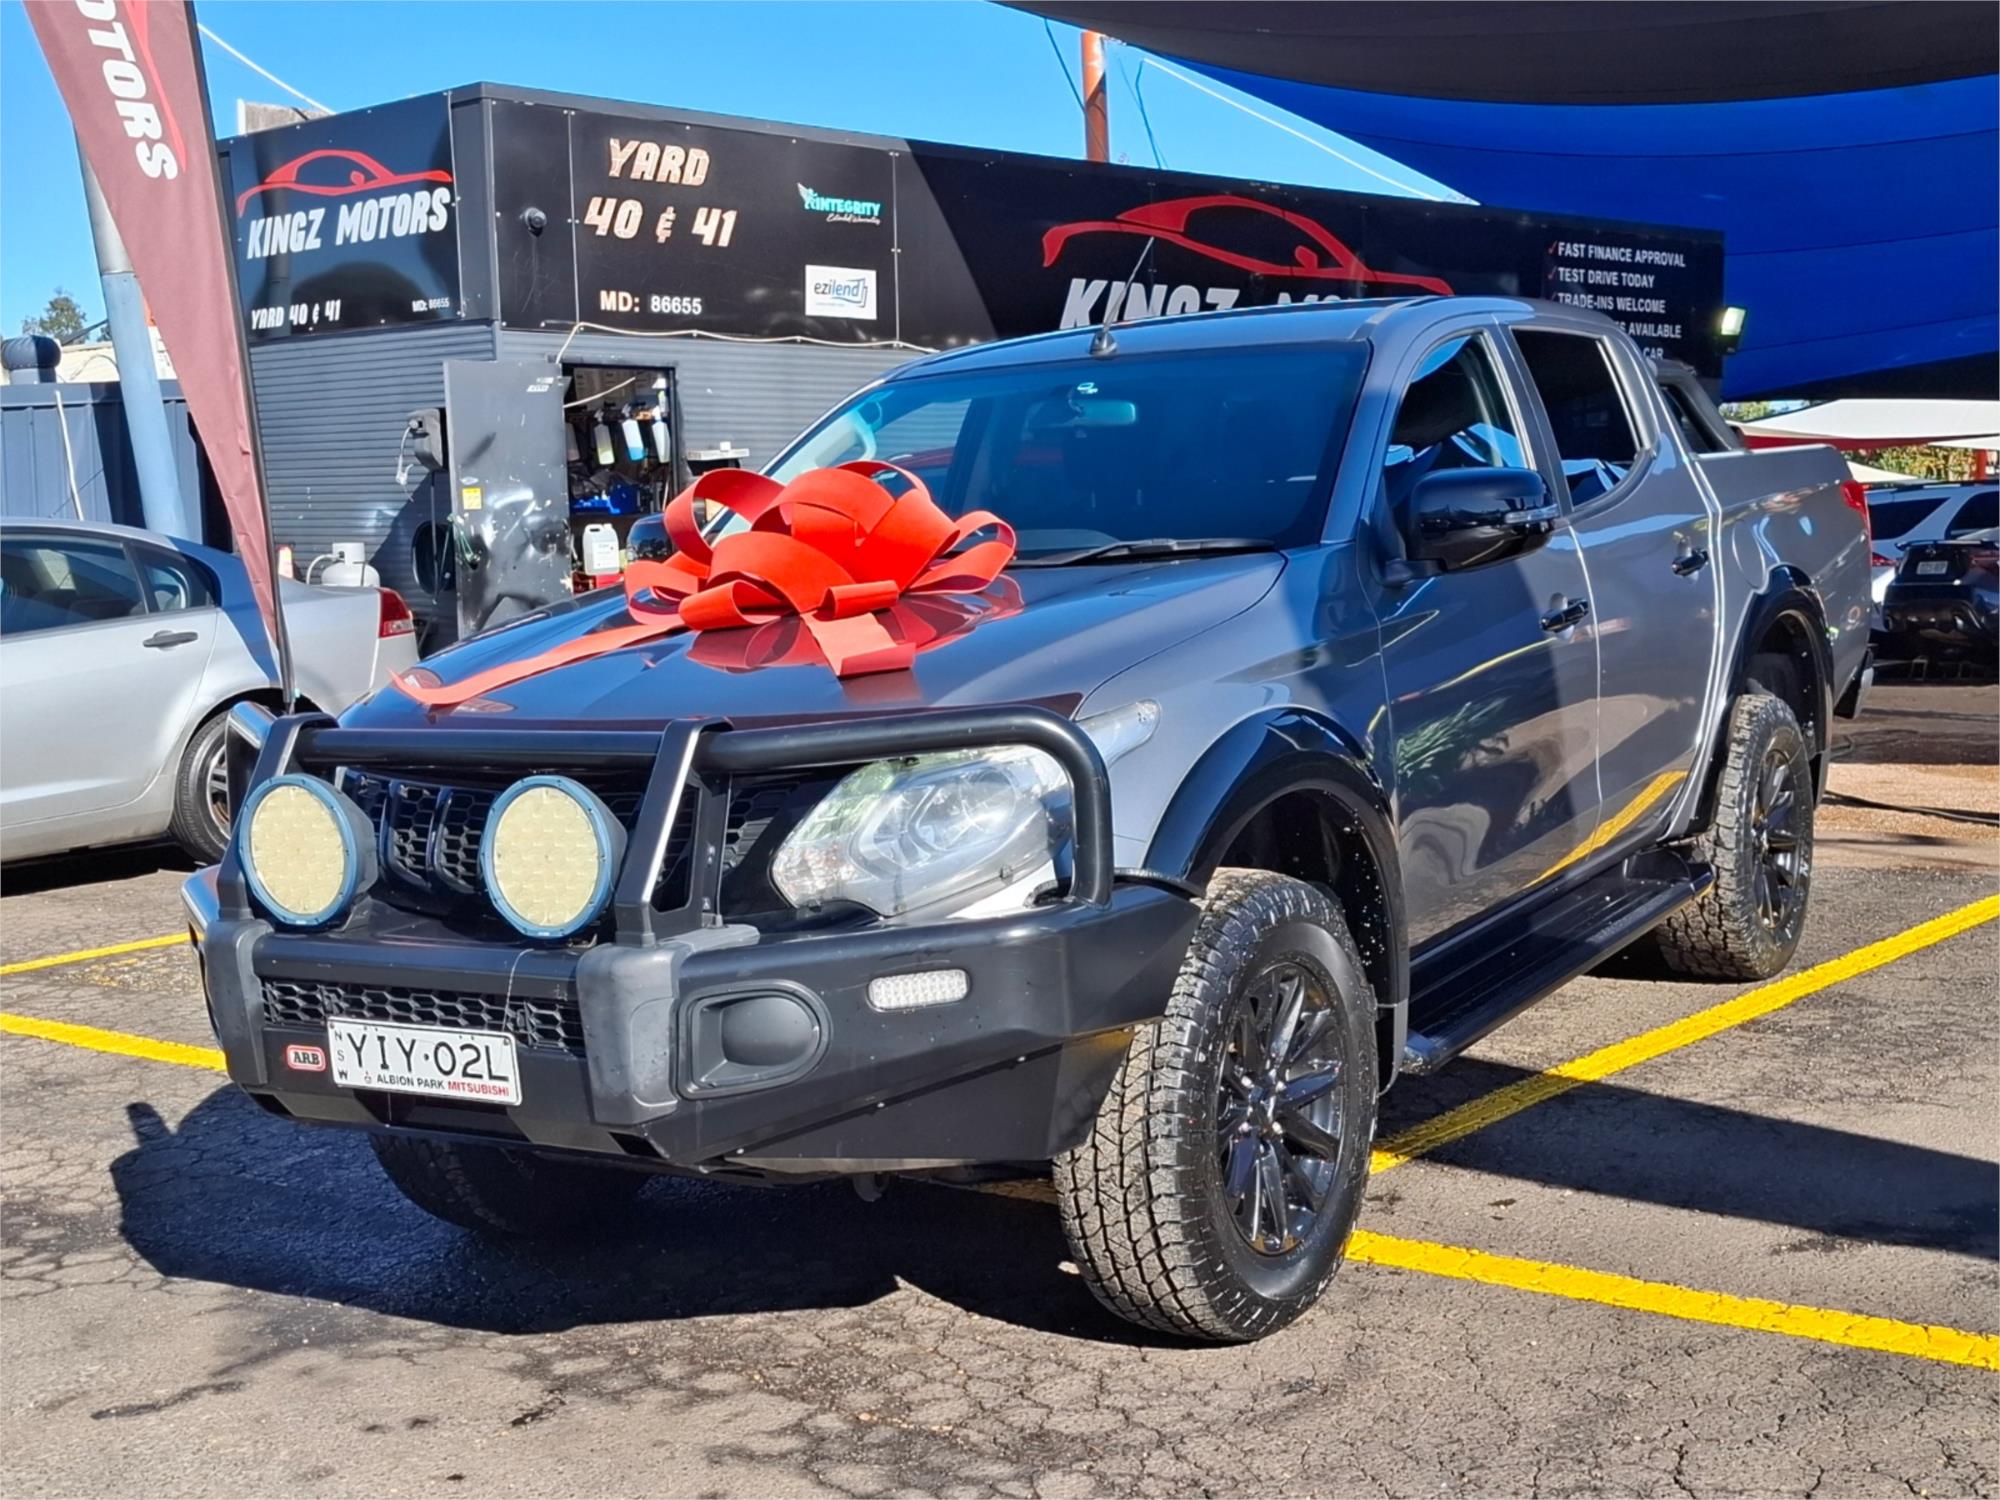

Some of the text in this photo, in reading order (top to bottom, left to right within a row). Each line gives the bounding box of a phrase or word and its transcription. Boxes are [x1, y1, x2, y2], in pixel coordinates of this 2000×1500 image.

[608, 138, 711, 187] YARD
[815, 196, 881, 217] INTEGRITY
[246, 187, 451, 260] KINGZ MOTORS
[583, 196, 644, 240] 40
[691, 207, 738, 248] 41
[1557, 241, 1687, 268] FAST FINANCE APPROVAL
[813, 279, 861, 297] ezilend
[1557, 266, 1655, 288] TEST DRIVE TODAY
[600, 289, 703, 315] MD: 86655
[1557, 292, 1667, 314] TRADE-INS WELCOME
[251, 306, 285, 330] YARD
[289, 303, 309, 326] 40
[324, 299, 341, 321] 41
[1628, 322, 1682, 339] AVAILABLE
[1643, 346, 1664, 360] CAR
[293, 1051, 320, 1065] ARB
[376, 1073, 510, 1097] ALBION PARK MITSUBISHI
